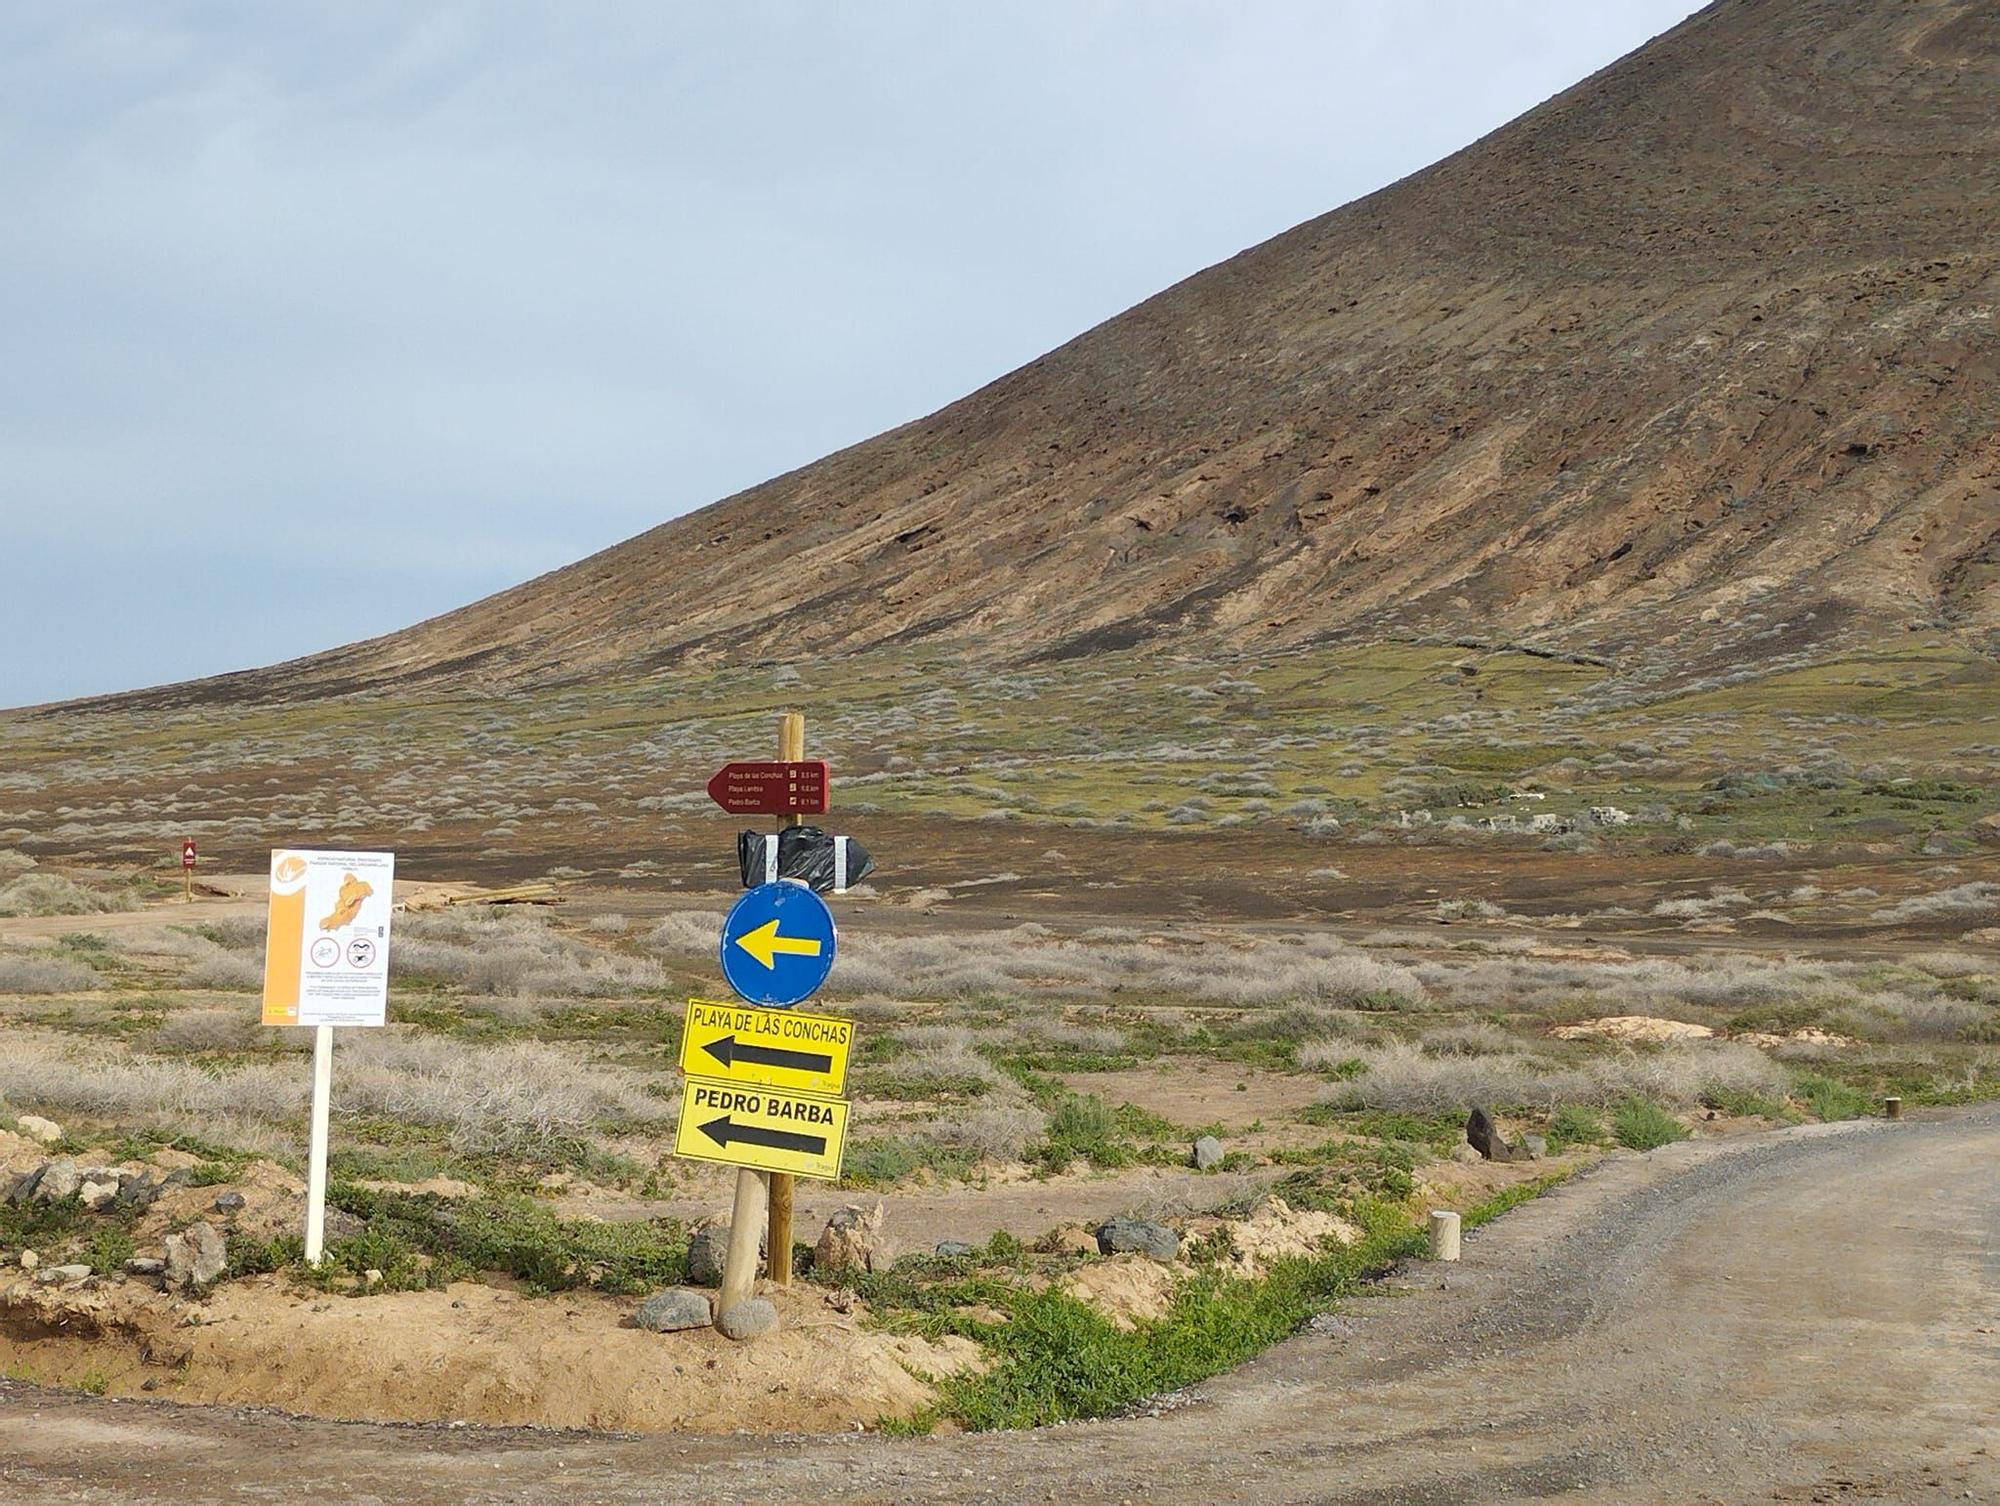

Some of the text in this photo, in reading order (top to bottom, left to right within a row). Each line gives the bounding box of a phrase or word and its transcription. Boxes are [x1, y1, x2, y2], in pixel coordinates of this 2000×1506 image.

[693, 1007, 847, 1045] PLAYA DE LAS CONCHAS
[695, 1088, 834, 1125] PEDRO BARBA
